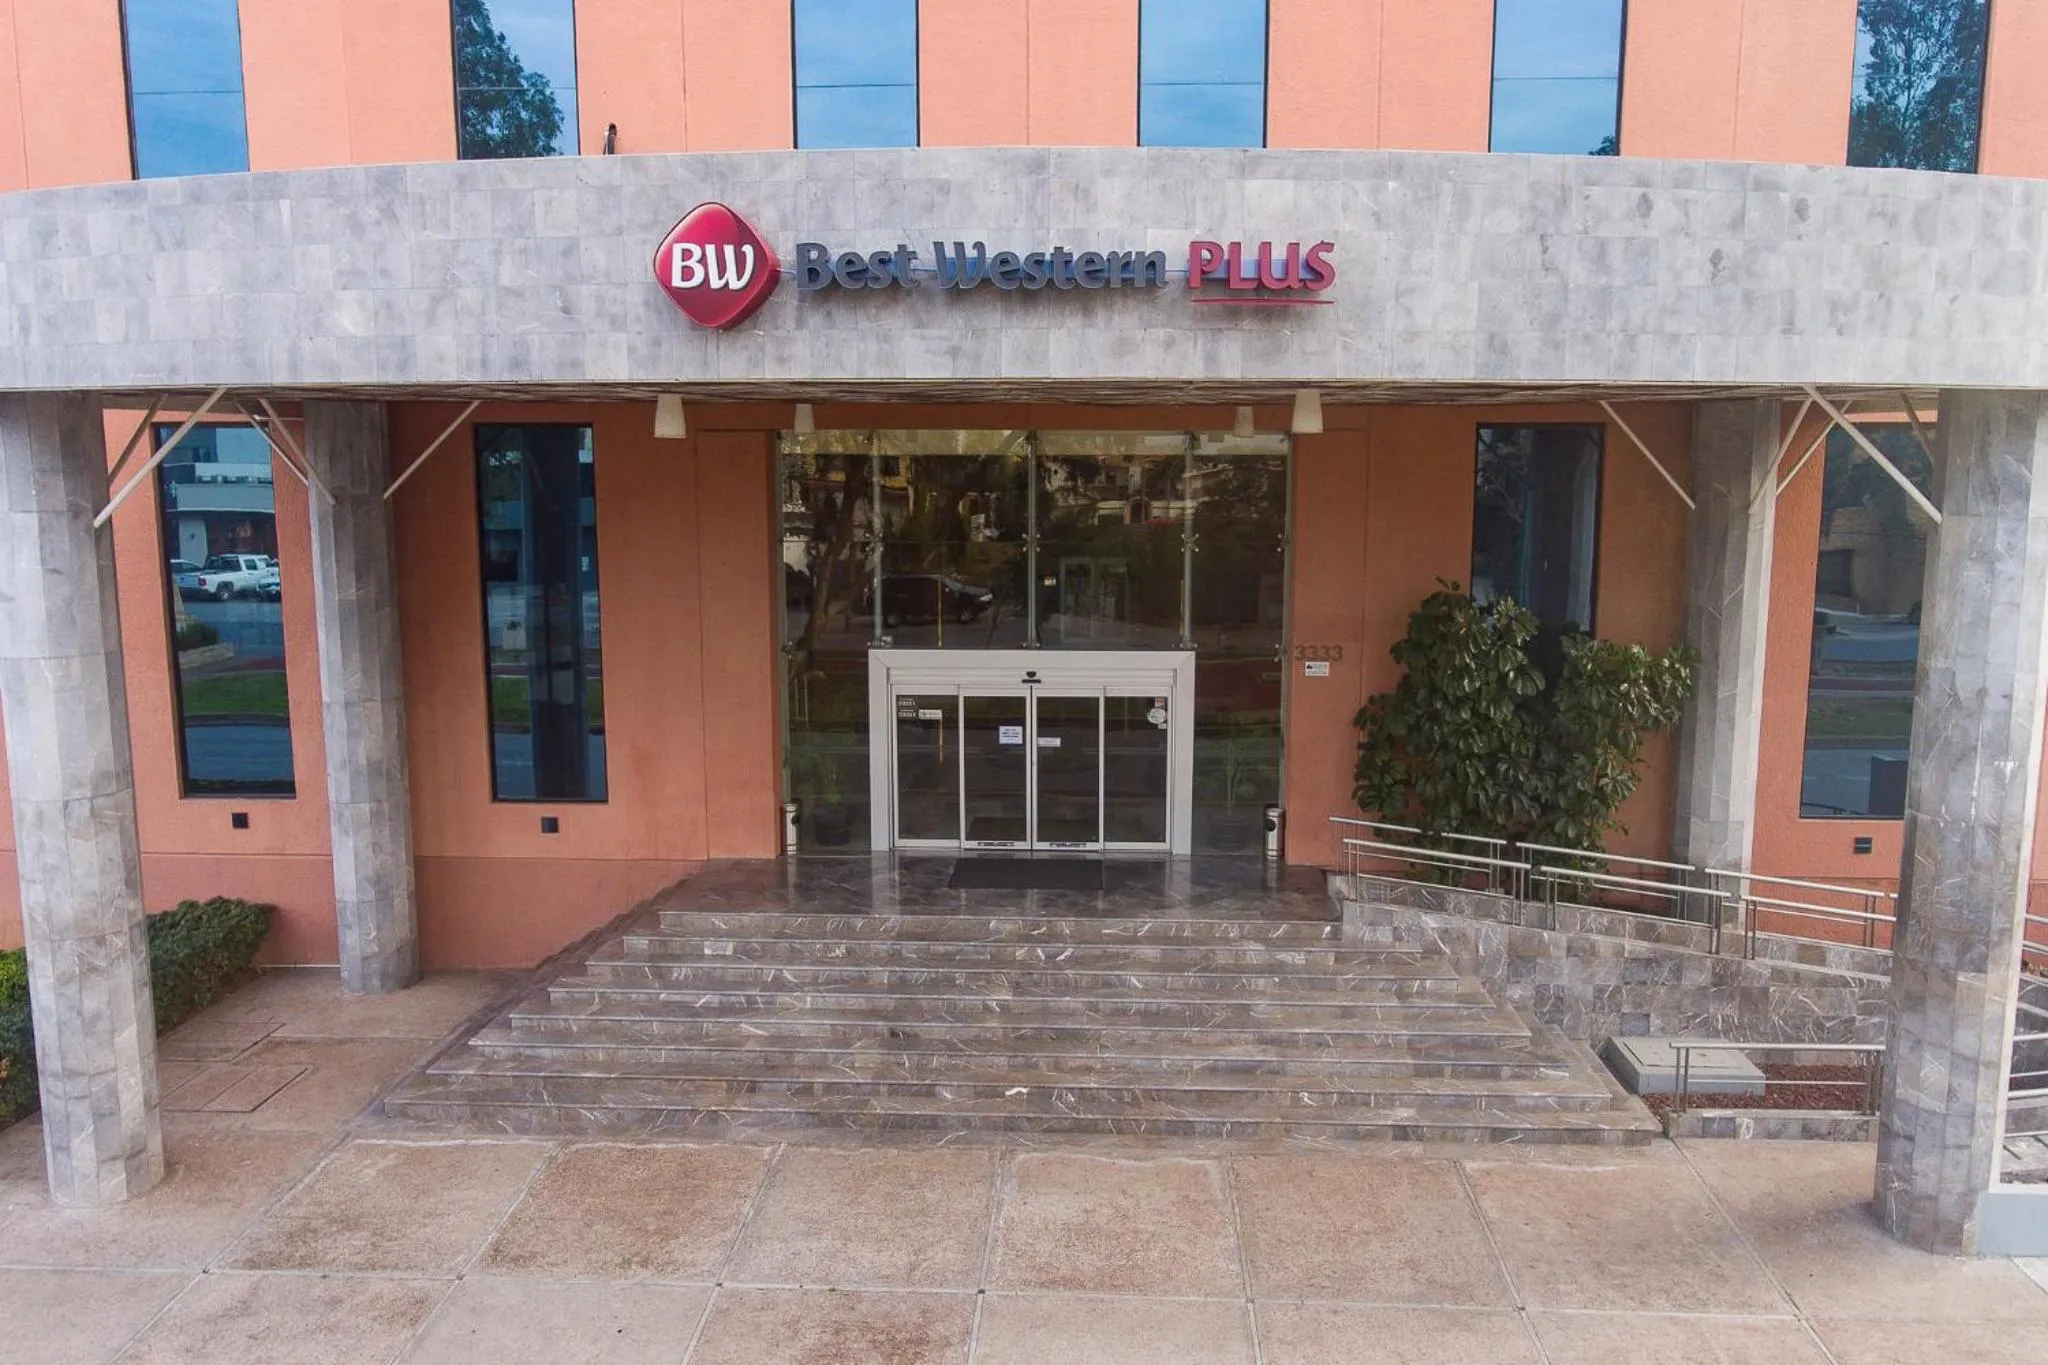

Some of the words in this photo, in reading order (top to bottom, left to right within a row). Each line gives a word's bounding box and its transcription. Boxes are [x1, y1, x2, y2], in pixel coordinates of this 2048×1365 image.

[671, 242, 755, 291] BW
[796, 242, 921, 290] Best
[932, 240, 1168, 290] Western
[1188, 240, 1336, 291] PLUS
